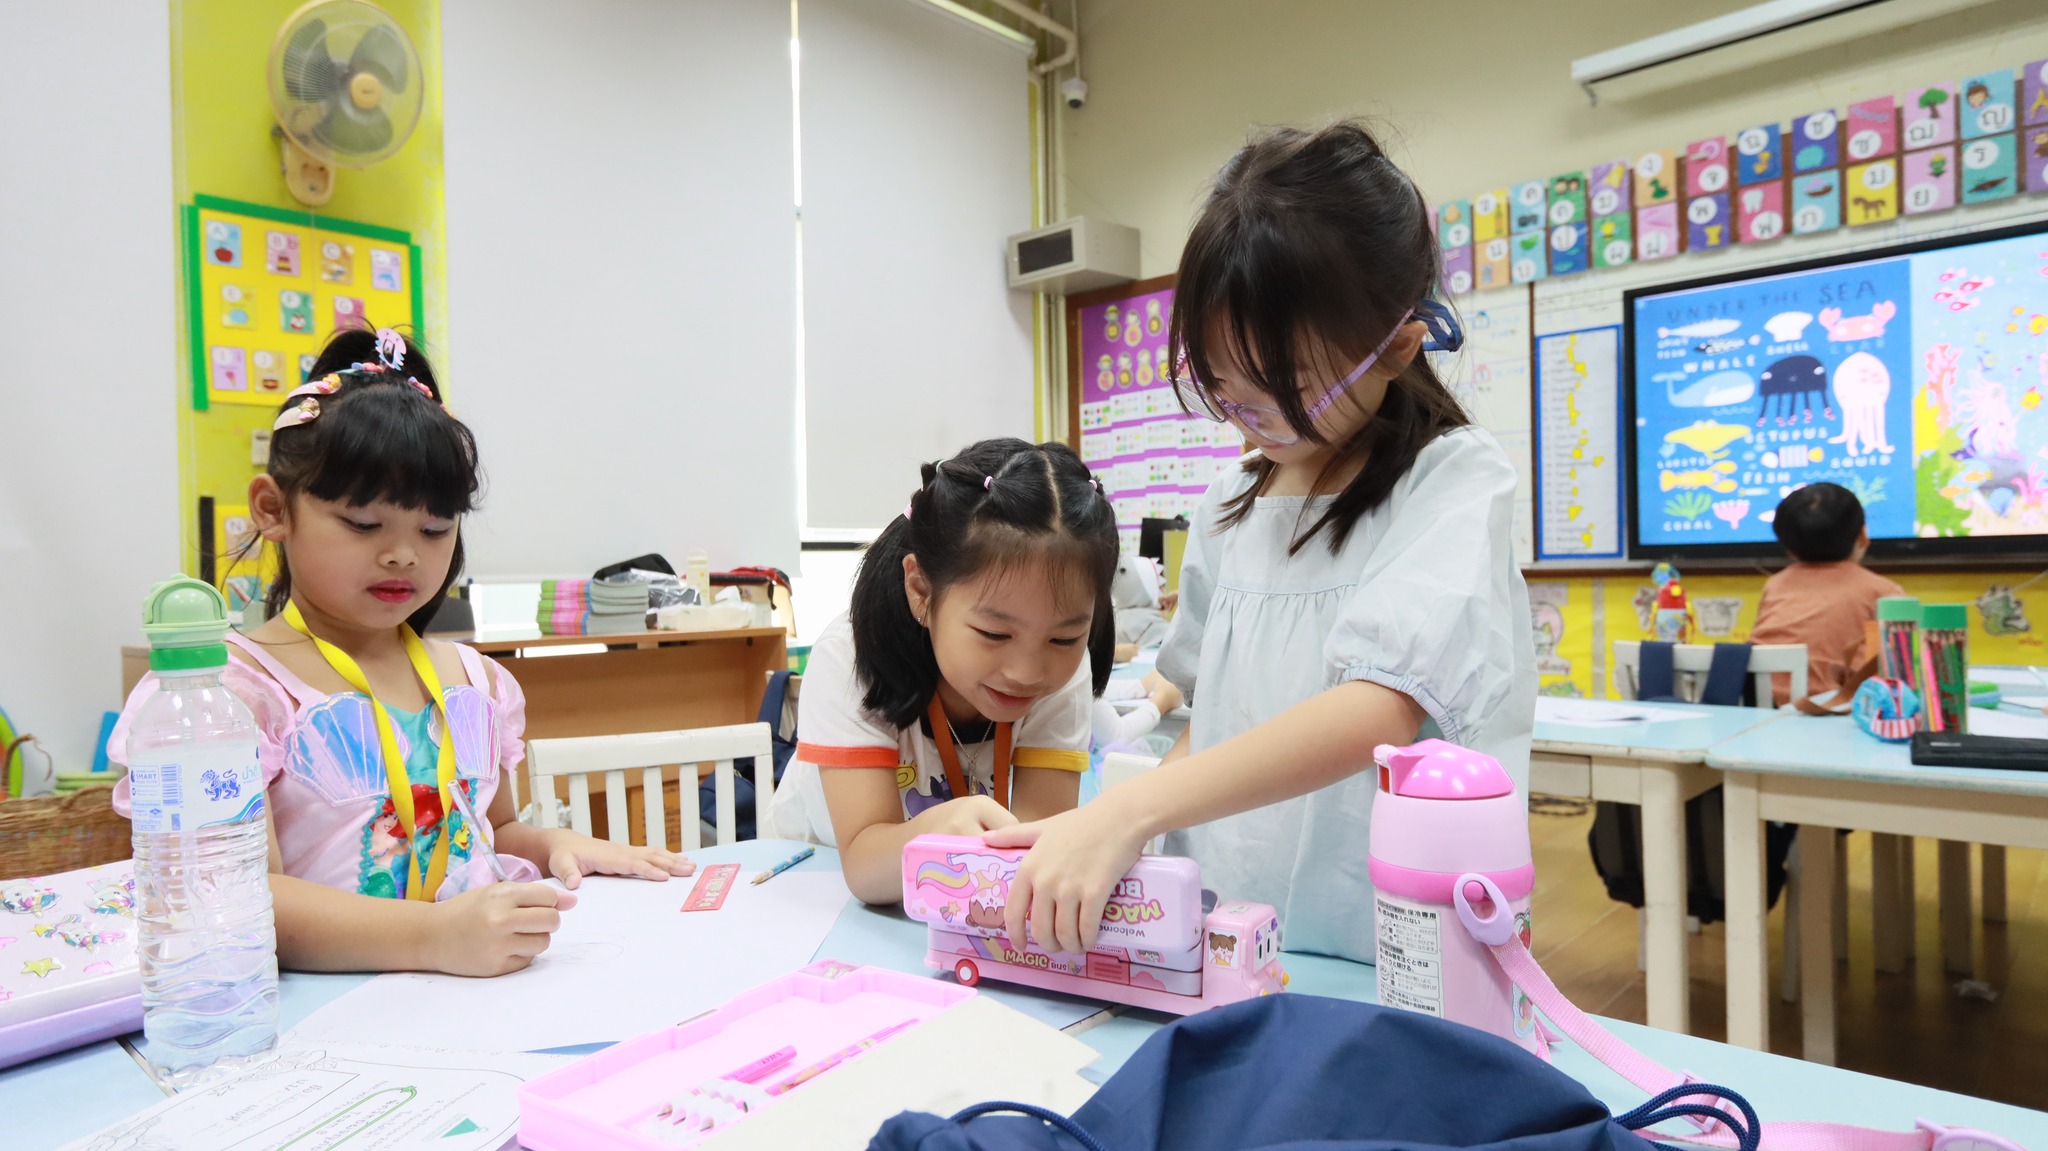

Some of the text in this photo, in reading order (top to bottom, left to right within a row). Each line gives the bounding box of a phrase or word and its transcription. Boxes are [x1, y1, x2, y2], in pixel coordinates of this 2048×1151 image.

[1667, 280, 1877, 322] UNDER THE SEA
[1682, 354, 1756, 374] WHALE
[1744, 426, 1828, 445] OCTOPUS
[1830, 454, 1892, 469] SQUID
[1742, 471, 1791, 485] FISH
[1663, 519, 1713, 533] CORAL
[1111, 878, 1144, 899] BU
[1103, 899, 1164, 924] MAG
[1004, 950, 1049, 969] MAGIC
